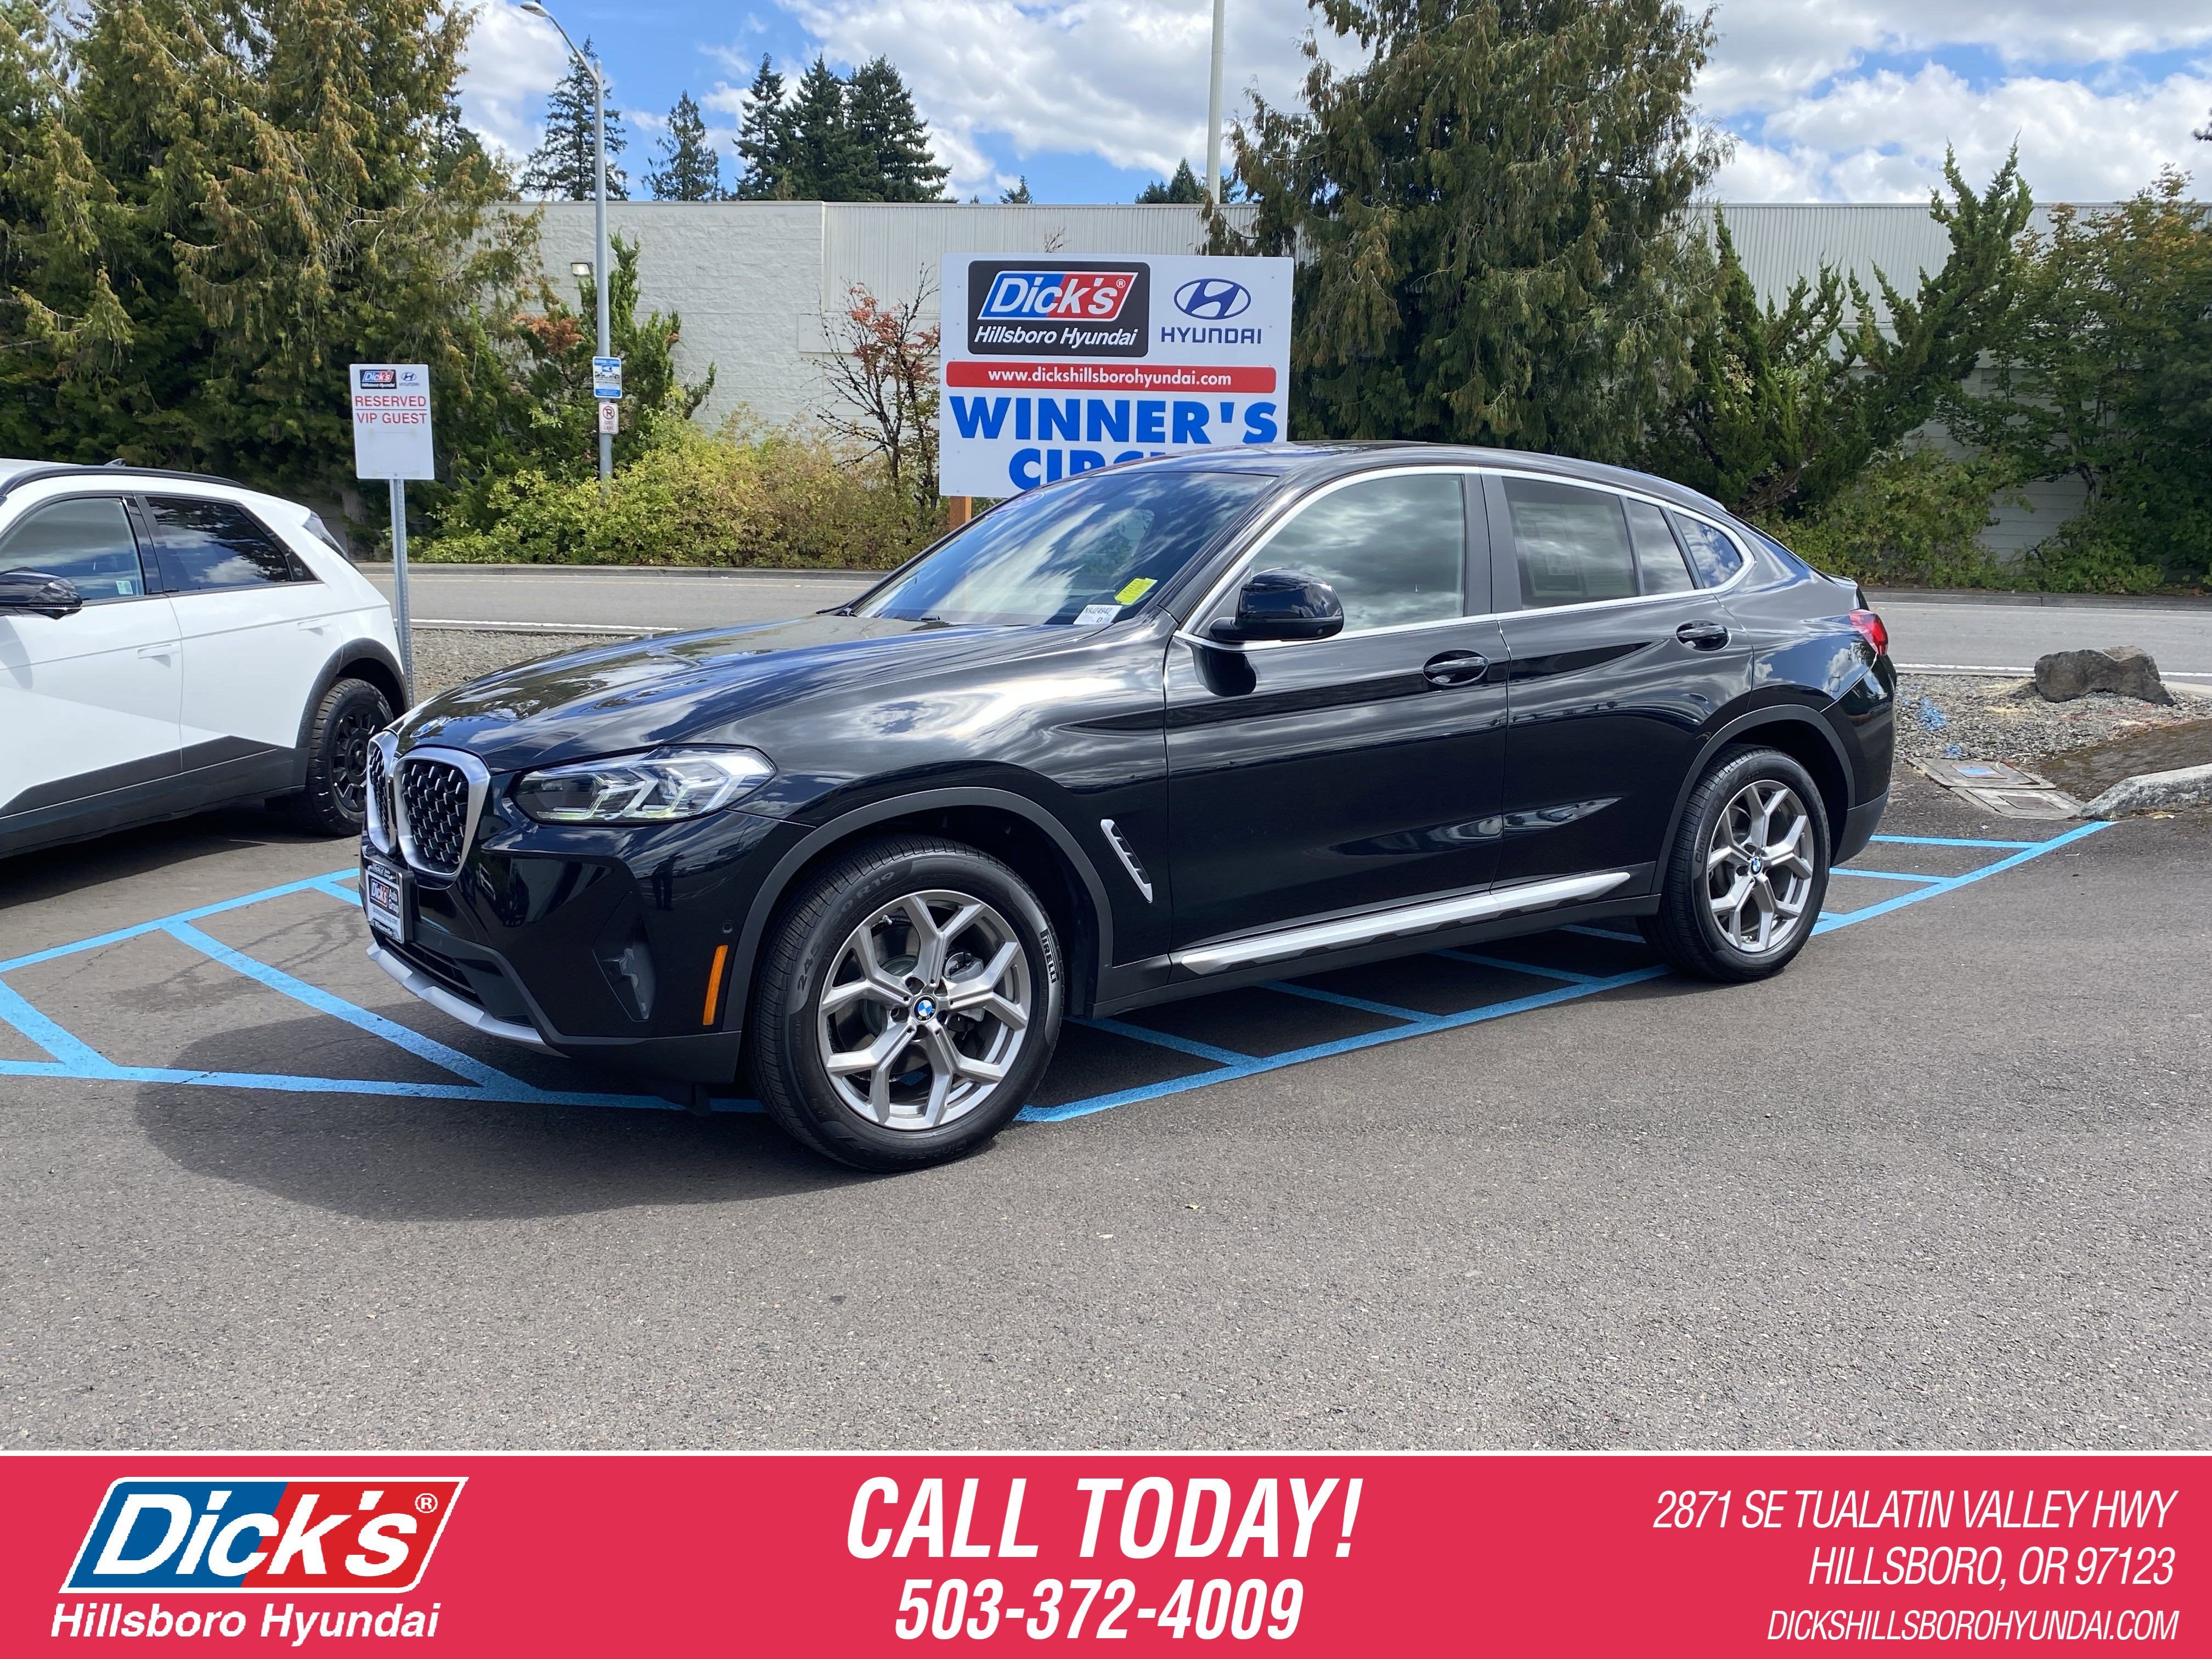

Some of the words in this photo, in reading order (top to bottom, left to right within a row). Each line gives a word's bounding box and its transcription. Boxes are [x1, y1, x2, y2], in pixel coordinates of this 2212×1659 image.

[990, 276, 1119, 314] Dick's
[974, 326, 1057, 345] Hillsboro
[1059, 327, 1139, 349] Hyundai
[1161, 326, 1262, 345] HYUNDAI
[364, 371, 392, 381] Dick's
[988, 367, 1232, 388] www.dickshillsborohyundai.com
[355, 396, 426, 407] RESERVED
[357, 413, 377, 424] VIP
[382, 413, 427, 424] GUEST
[949, 396, 1278, 444] WINNER'S
[371, 881, 387, 904] Dick's
[1040, 928, 1060, 984] PIRELLI
